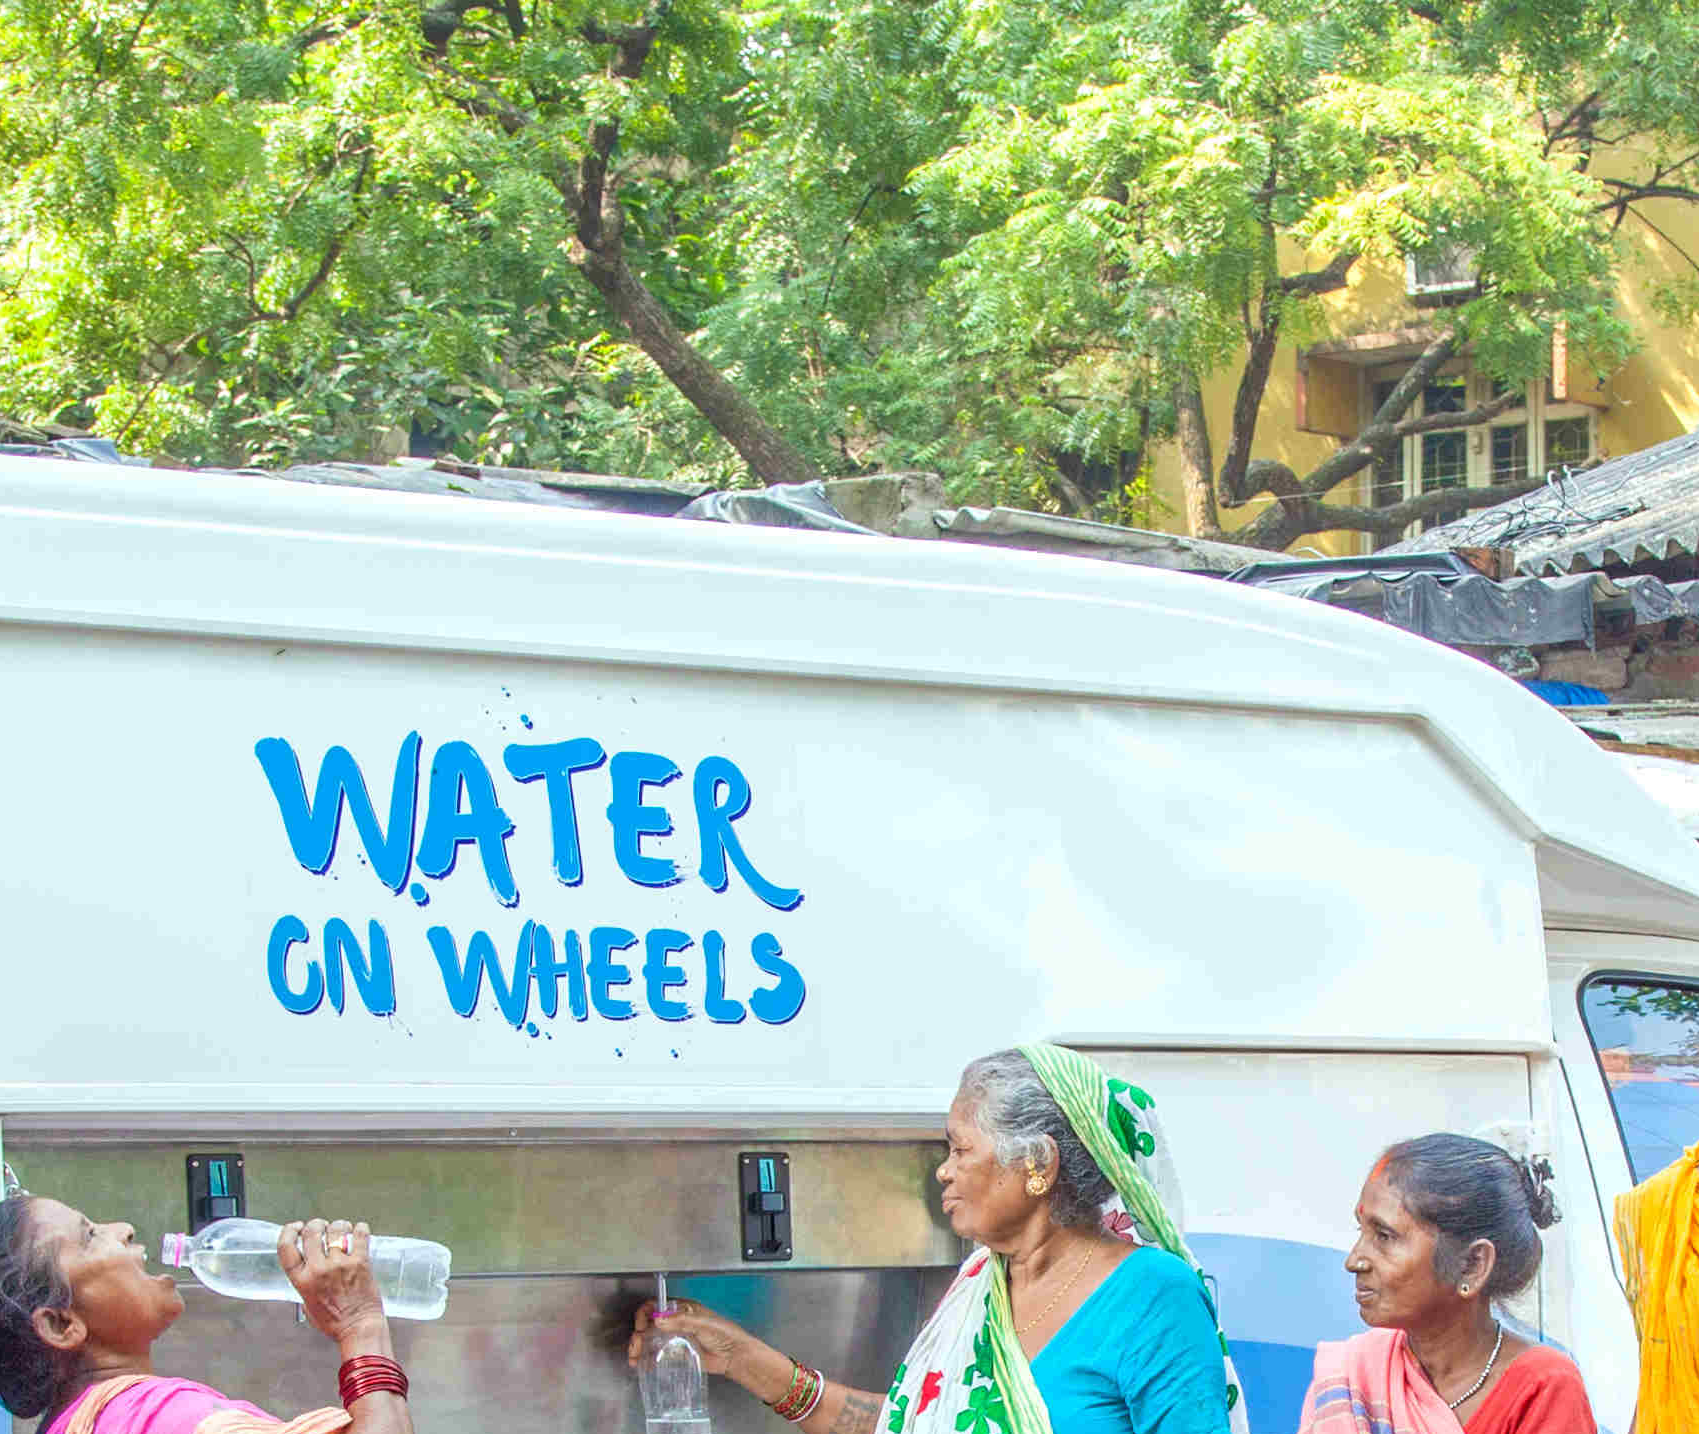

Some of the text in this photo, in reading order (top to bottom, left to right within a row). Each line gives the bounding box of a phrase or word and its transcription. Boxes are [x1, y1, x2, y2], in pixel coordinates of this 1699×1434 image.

[255, 731, 804, 911] WATER
[267, 915, 806, 1029] ON WHEELS
